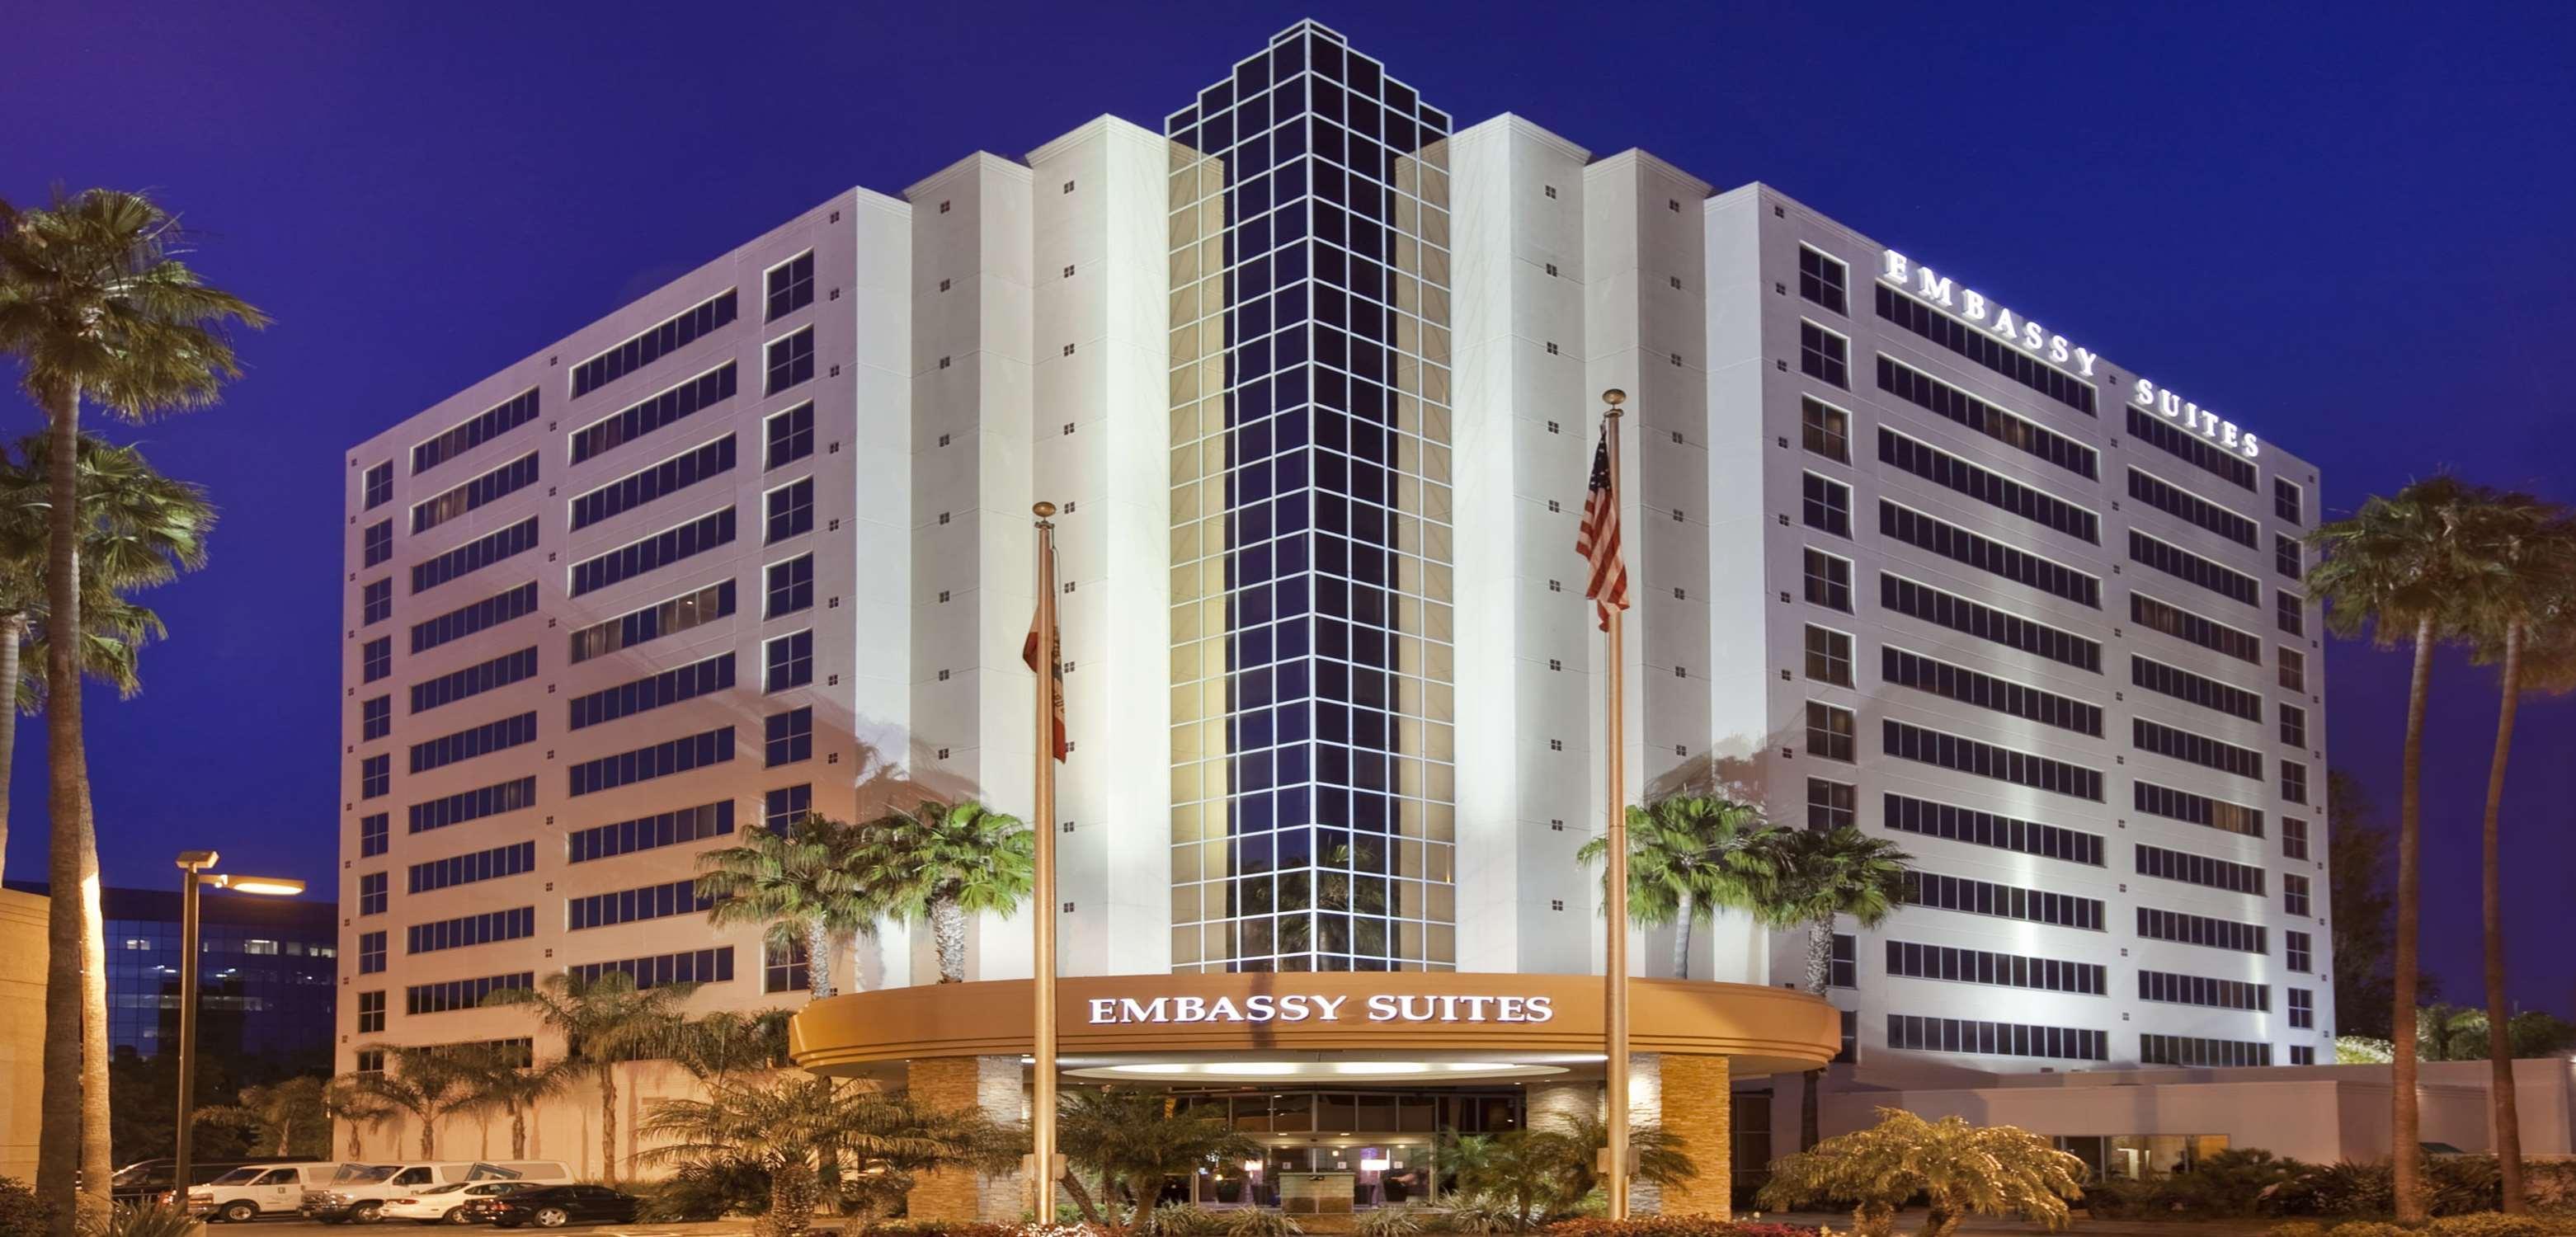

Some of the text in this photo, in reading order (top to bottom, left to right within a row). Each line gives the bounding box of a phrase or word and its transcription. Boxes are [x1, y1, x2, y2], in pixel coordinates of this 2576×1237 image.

[1883, 249, 2260, 457] EMBASSY SUITES
[1089, 995, 1553, 1023] EMBASSY SUITES
